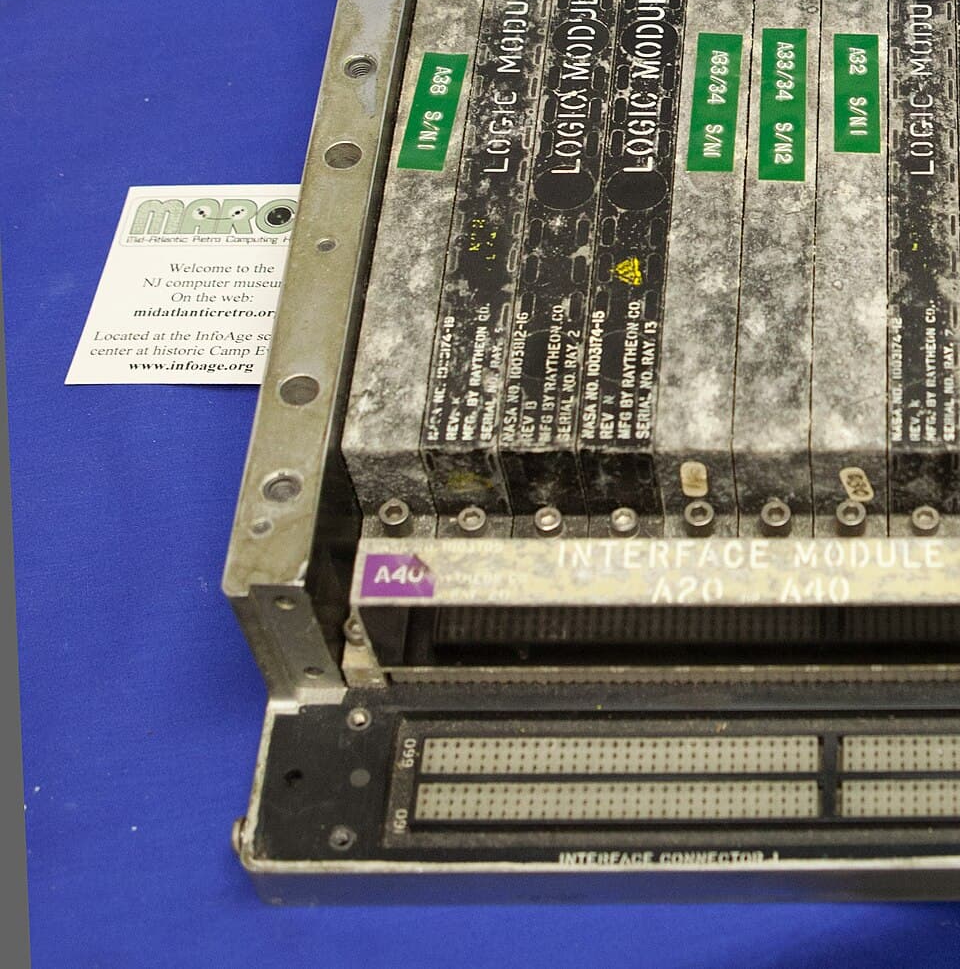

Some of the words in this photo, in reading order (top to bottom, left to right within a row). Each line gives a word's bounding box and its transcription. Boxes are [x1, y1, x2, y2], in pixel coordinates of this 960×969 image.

[775, 41, 794, 101] A33/34
[849, 46, 867, 74] A32
[430, 65, 452, 96] A38
[707, 49, 730, 104] A33/34
[417, 110, 442, 151] S/N1
[849, 96, 869, 136] S/N1
[483, 91, 518, 174] LOGIC
[551, 94, 587, 175] LOGIC
[622, 92, 657, 173] LOGIC
[703, 123, 723, 159] S/N1
[774, 122, 793, 165] S/N2
[909, 93, 934, 175] LOGIC
[143, 277, 163, 288] NJ
[165, 279, 231, 291] computer
[169, 263, 233, 274] Welcome
[236, 264, 250, 274] to
[253, 263, 275, 274] the
[133, 308, 276, 318] midatlanticretro.or
[171, 292, 192, 303] On
[196, 292, 217, 303] the
[221, 292, 254, 303] web:
[89, 347, 133, 357] center
[135, 347, 149, 357] at
[153, 345, 205, 357] historic
[209, 346, 251, 359] Camp
[93, 331, 150, 342] Located
[153, 332, 167, 342] at
[170, 331, 191, 342] the
[195, 331, 254, 344] InfoAge
[128, 361, 254, 373] www.infoage.org
[622, 322, 640, 387] RAYTHEON
[621, 391, 633, 408] BY
[581, 403, 598, 439] NASA
[600, 412, 615, 439] REV
[618, 411, 632, 439] MFG
[635, 392, 652, 439] SERIAL
[557, 540, 770, 569] INTERFACE
[793, 539, 946, 569] MODULE
[779, 577, 850, 604] A40
